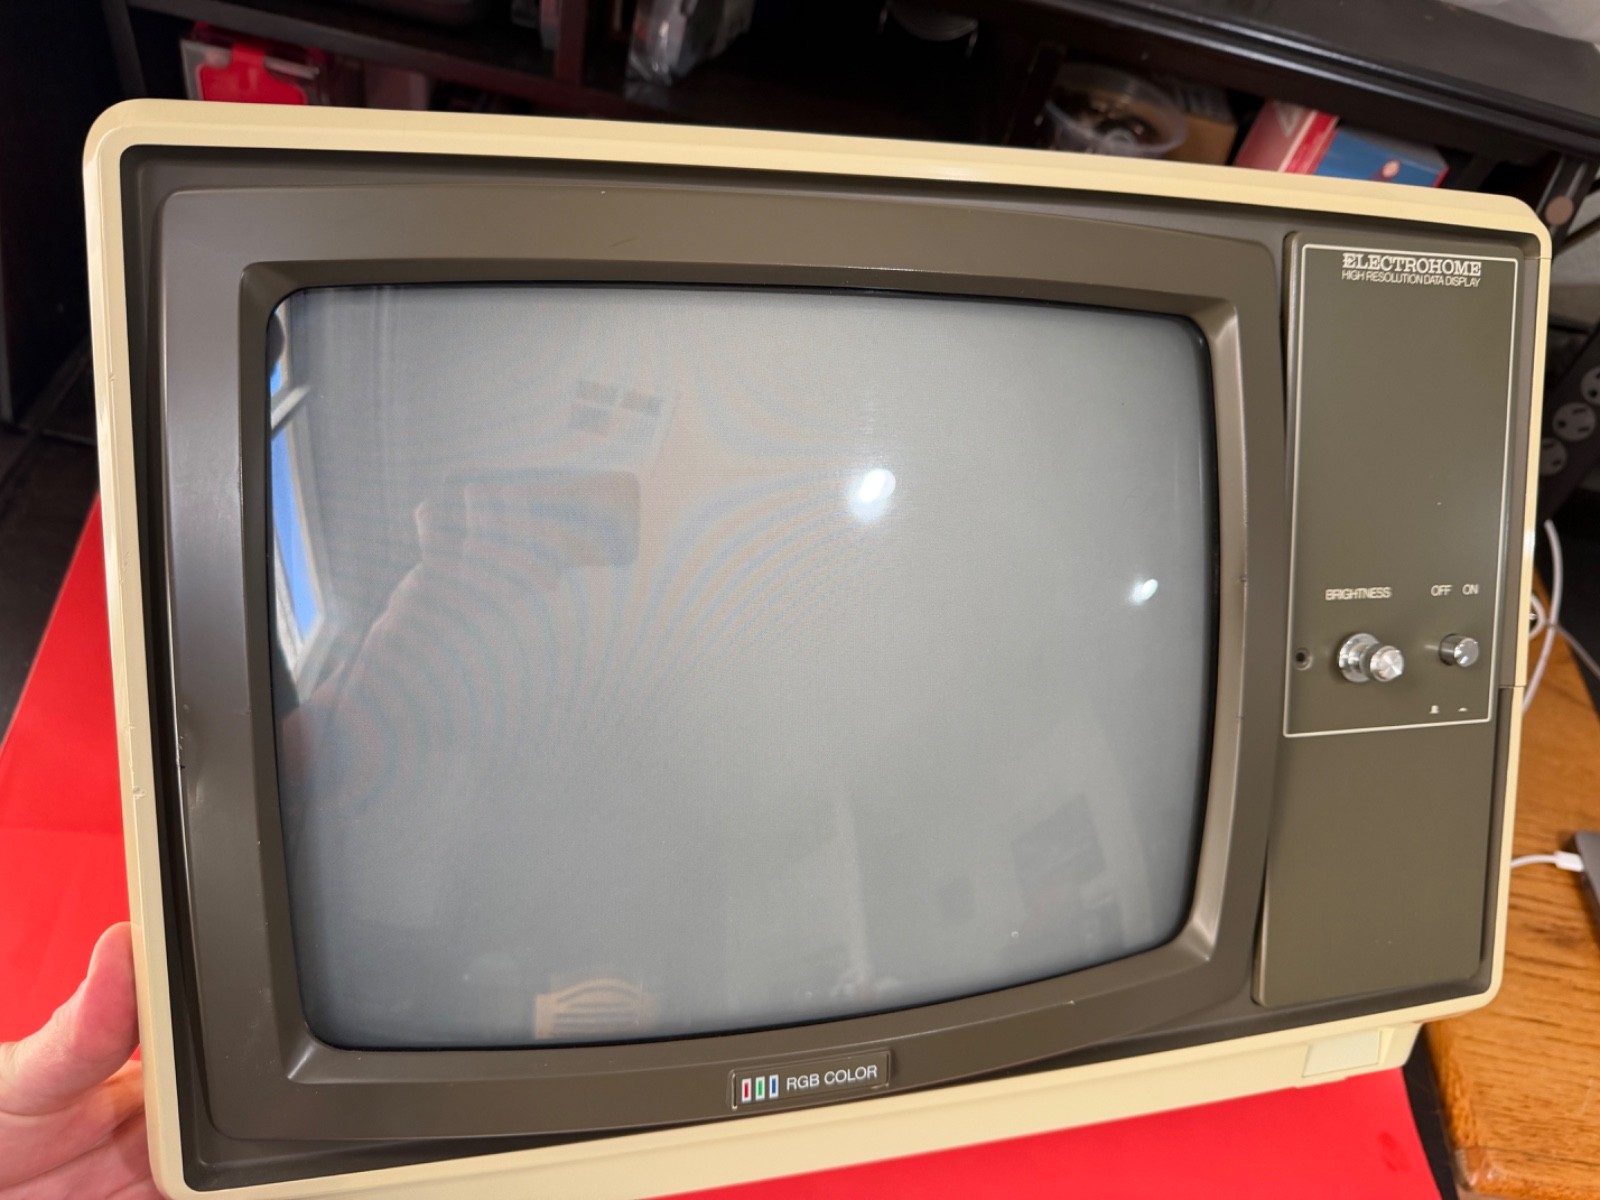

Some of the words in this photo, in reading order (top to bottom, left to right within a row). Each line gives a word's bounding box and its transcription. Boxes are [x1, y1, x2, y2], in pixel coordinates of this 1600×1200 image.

[1342, 253, 1481, 276] ELECTROHOME
[1342, 270, 1364, 281] HIGH
[1366, 271, 1422, 284] RESOLUTION
[1424, 275, 1444, 286] DATA
[1446, 277, 1480, 287] DISPLAY
[1325, 587, 1391, 600] BRIGHTNESS
[1431, 585, 1452, 596] OFF
[1463, 584, 1477, 595] ON
[786, 1073, 820, 1091] RGB
[824, 1064, 878, 1085] COLOR
